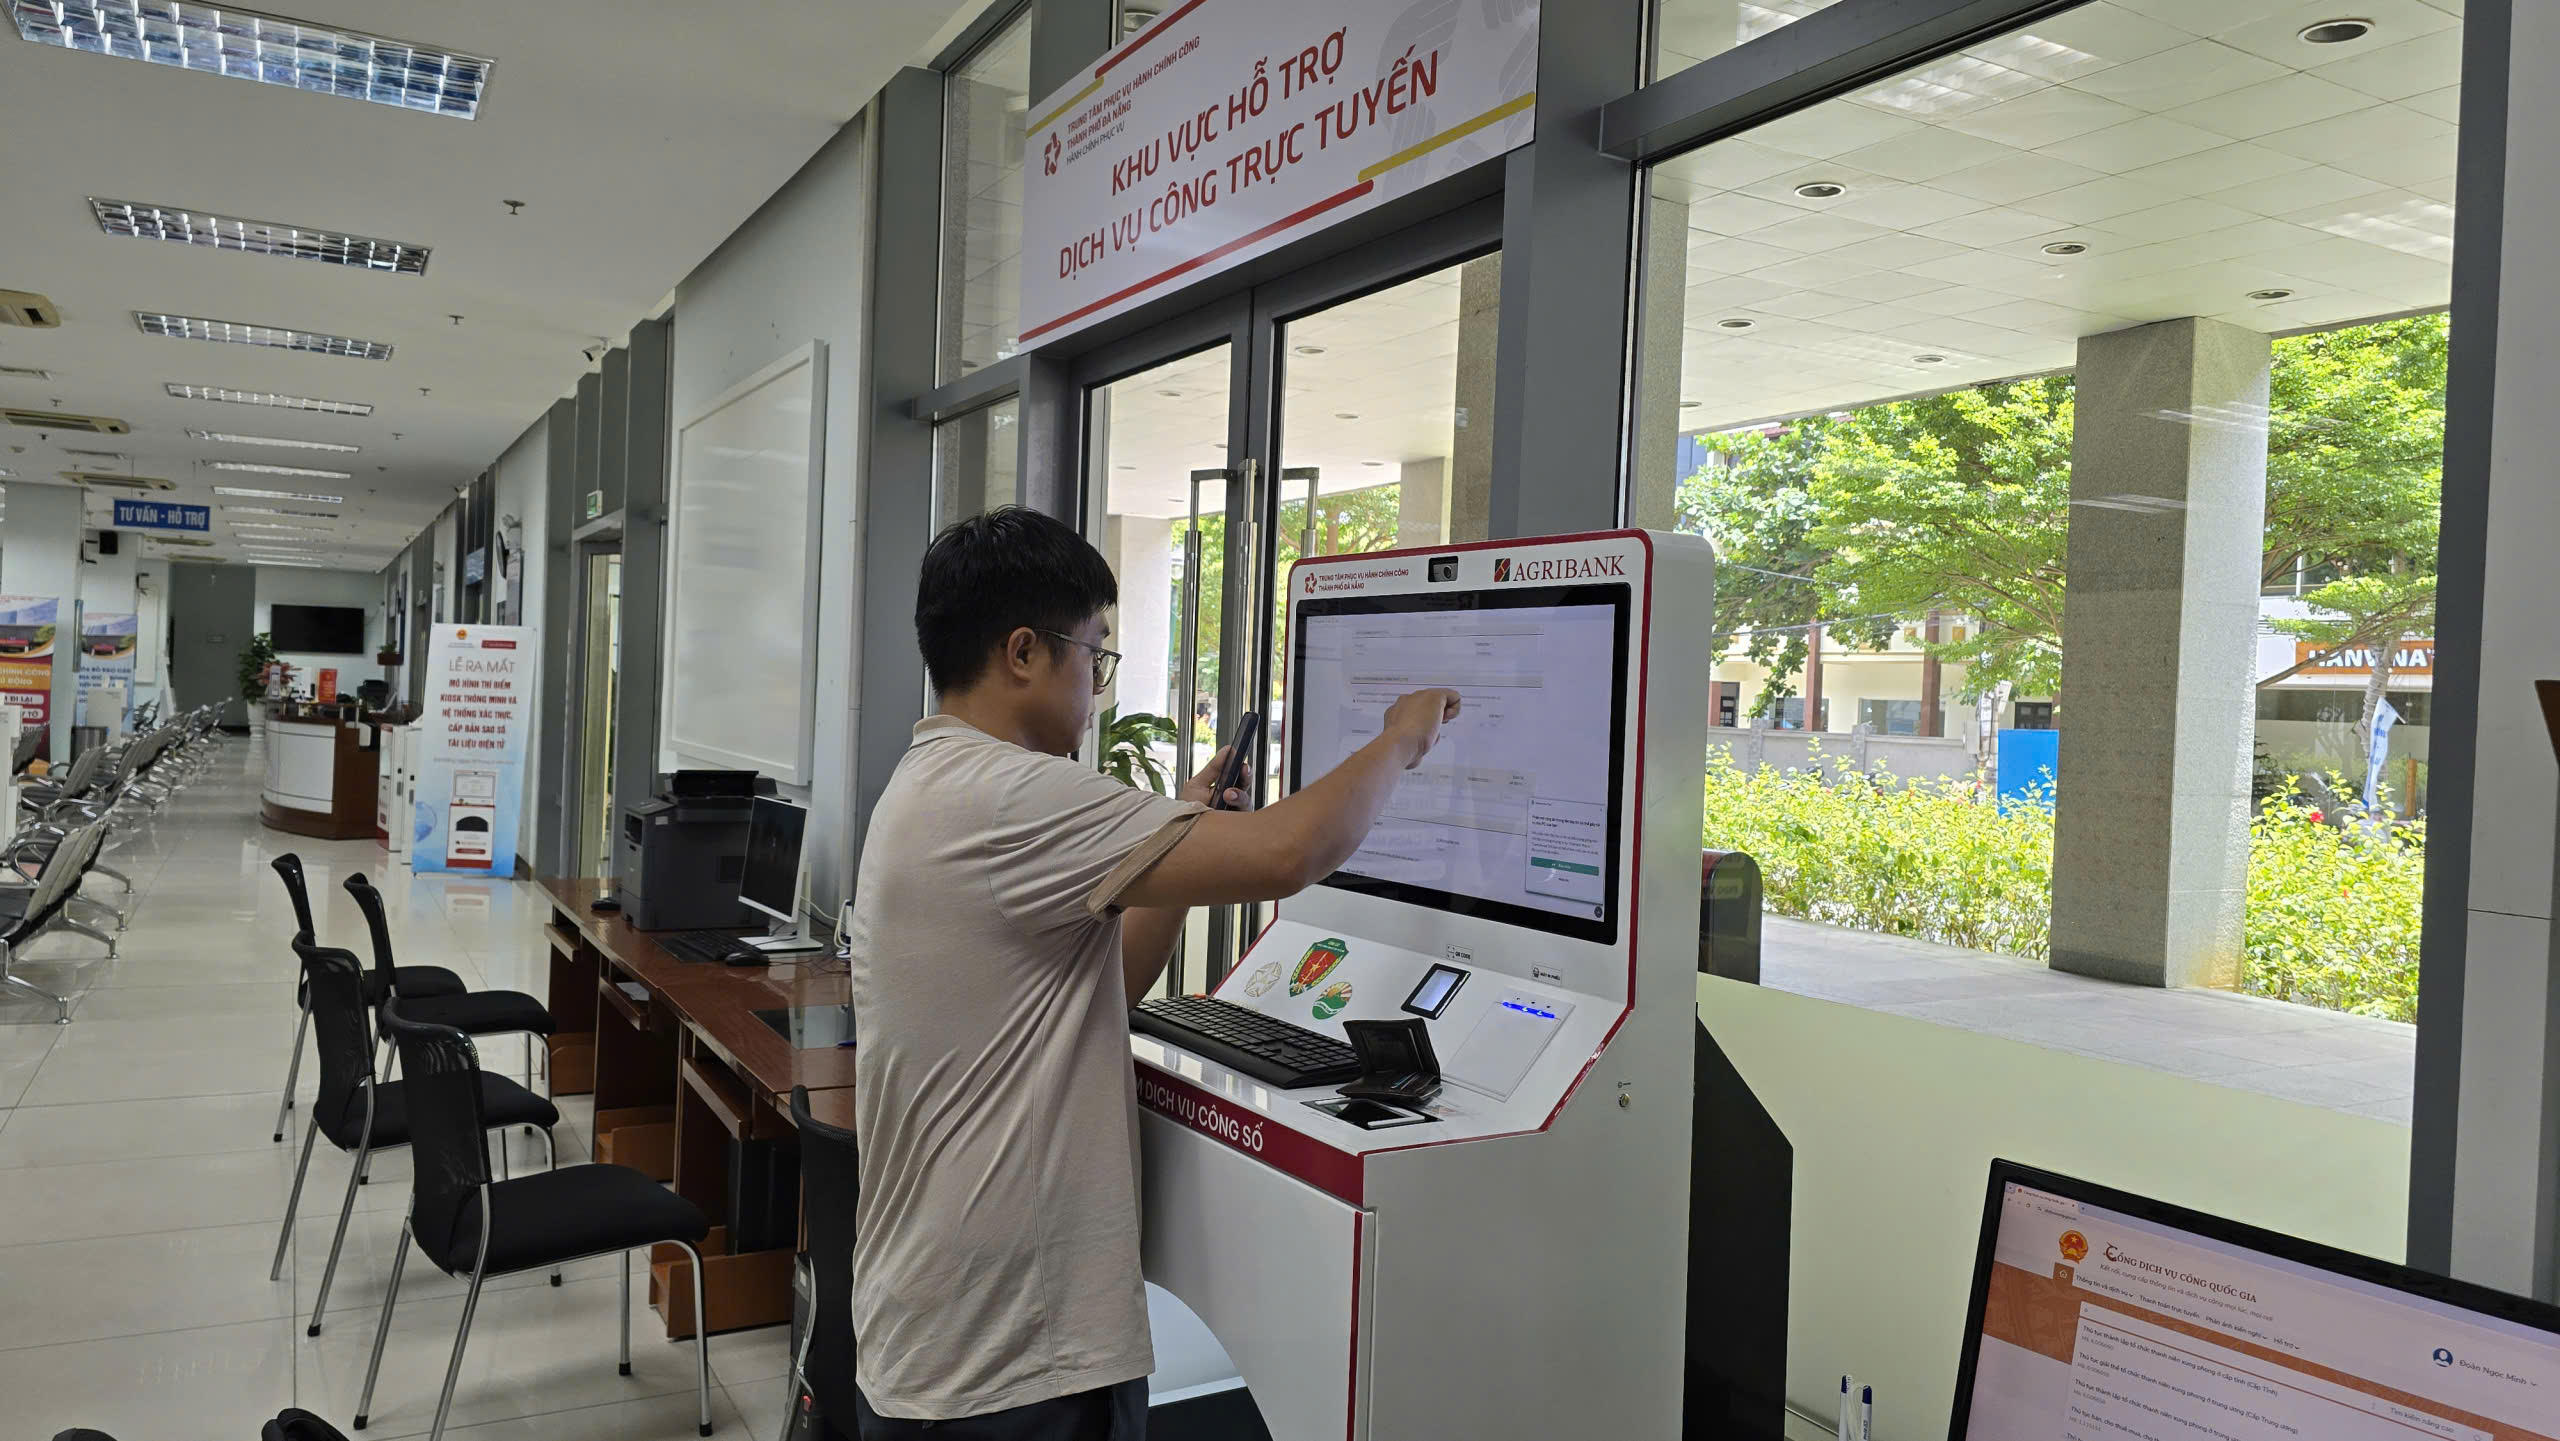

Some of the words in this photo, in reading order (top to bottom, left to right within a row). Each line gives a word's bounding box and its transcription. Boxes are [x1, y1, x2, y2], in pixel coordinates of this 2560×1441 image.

[1068, 112, 1087, 134] TRUNG
[1088, 102, 1102, 118] TÂM
[1104, 90, 1121, 110] PHỤC
[1122, 82, 1131, 96] VỤ
[1133, 68, 1152, 90] HÀNH
[1154, 50, 1177, 76] CHÍNH
[1179, 36, 1200, 58] CÔNG
[1112, 139, 1159, 196] KHU
[1168, 104, 1219, 162] VỰC
[1228, 56, 1268, 131] HỖ
[1279, 26, 1346, 100] TRỢ
[1067, 128, 1088, 150] THÀNH
[1088, 116, 1101, 136] PHỐ
[1102, 112, 1111, 128] ĐÀ
[1112, 100, 1131, 122] NẴNG
[1060, 228, 1104, 280] DỊCH
[1112, 208, 1142, 252] VỤ
[1150, 169, 1217, 232] CÔNG
[1227, 123, 1304, 194] TRỰC
[1315, 43, 1438, 150] TUYẾN
[120, 506, 135, 521] TƯ
[136, 506, 158, 522] VẤN
[168, 506, 182, 524] HỖ
[185, 511, 206, 528] TRỢ
[1345, 573, 1357, 581] PHỤC
[1365, 570, 1377, 578] HÀNH
[1379, 569, 1393, 578] CHÍNH
[1394, 568, 1408, 576] CÔNG
[1513, 555, 1626, 581] AGRIBANK
[1319, 584, 1333, 592] THÀNH
[1334, 582, 1343, 591] PHỐ
[1344, 582, 1351, 590] ĐÀ
[1351, 581, 1364, 590] NẴNG
[449, 656, 462, 672] LỄ
[466, 660, 483, 672] RA
[440, 694, 461, 702] KIOSK
[464, 694, 486, 703] THÔNG
[489, 696, 506, 704] MINH
[1145, 1081, 1174, 1112] DỊCH
[1178, 1095, 1195, 1126] VỤ
[1199, 1104, 1239, 1140] CÔNG
[1242, 1122, 1263, 1152] SỐ
[2076, 1274, 2093, 1287] Thông
[2139, 1261, 2162, 1275] DỊCH
[2164, 1268, 2178, 1280] VỤ
[2180, 1272, 2207, 1288] CÔNG
[2209, 1281, 2237, 1297] QUỐC
[2239, 1290, 2257, 1303] GIA
[2459, 1359, 2481, 1372] Đoàn
[2483, 1366, 2503, 1380] Ngọc
[2506, 1373, 2527, 1385] Minh
